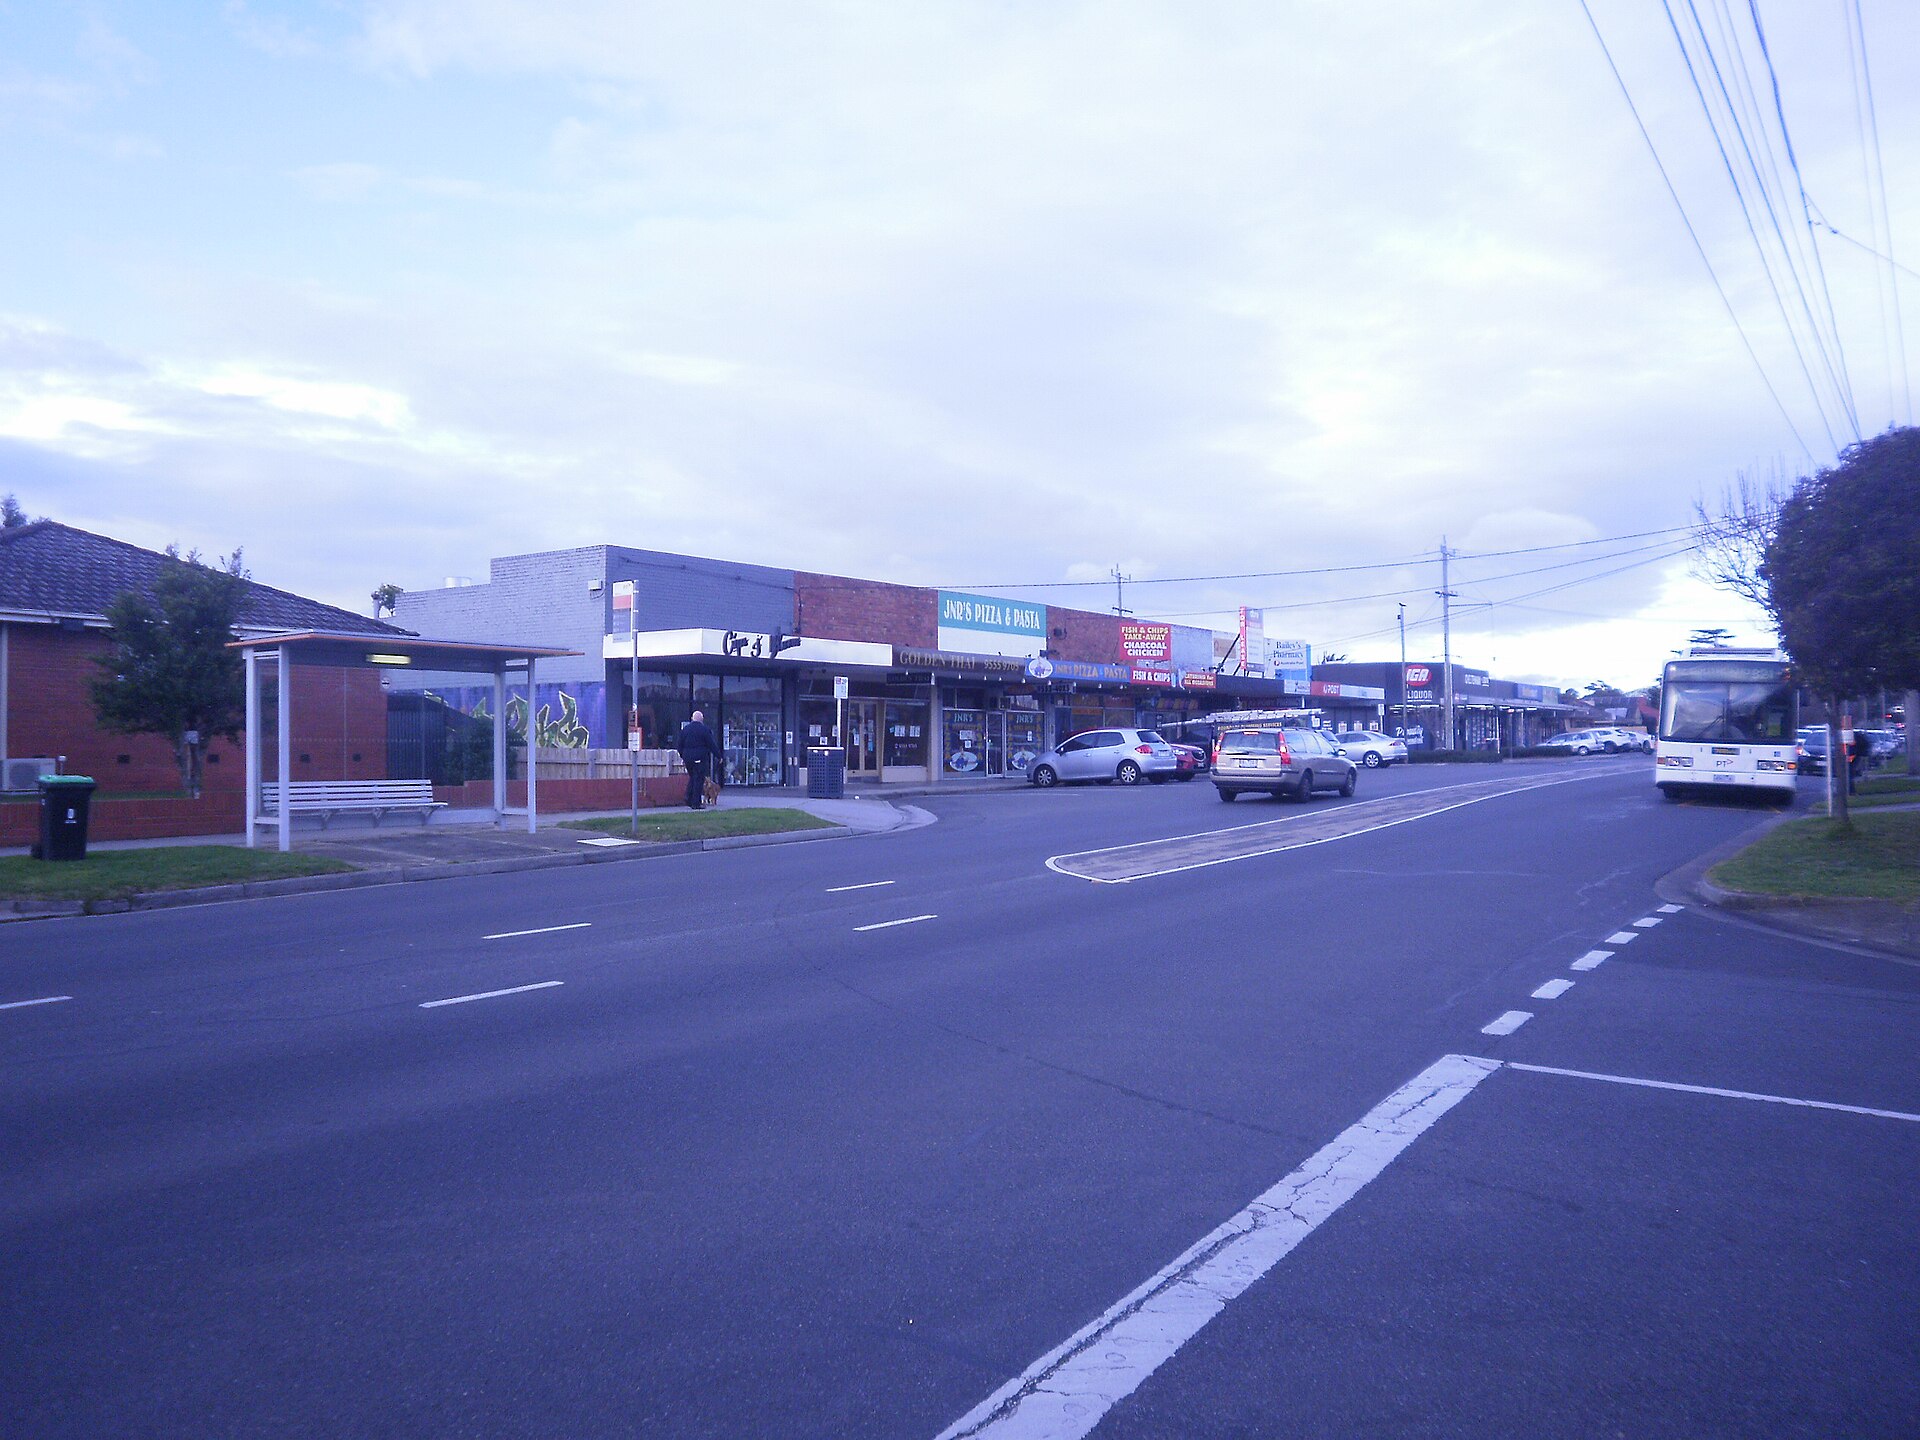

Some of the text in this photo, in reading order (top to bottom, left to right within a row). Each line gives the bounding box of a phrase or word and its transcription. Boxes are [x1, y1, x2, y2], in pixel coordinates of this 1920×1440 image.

[944, 600, 1040, 630] JNR'S PIZZA & PASTA
[1124, 642, 1167, 650] CHARCOAL
[899, 650, 946, 667] GOLDEN
[949, 655, 976, 669] THAI
[1127, 649, 1164, 657] CHICKEN
[1073, 665, 1099, 678] PIZZA
[1104, 666, 1128, 679] PASTA
[1132, 670, 1171, 683] FISH & CHIPS
[1406, 668, 1429, 682] IGA
[1328, 684, 1340, 694] POST
[1407, 690, 1433, 699] LIQUOR
